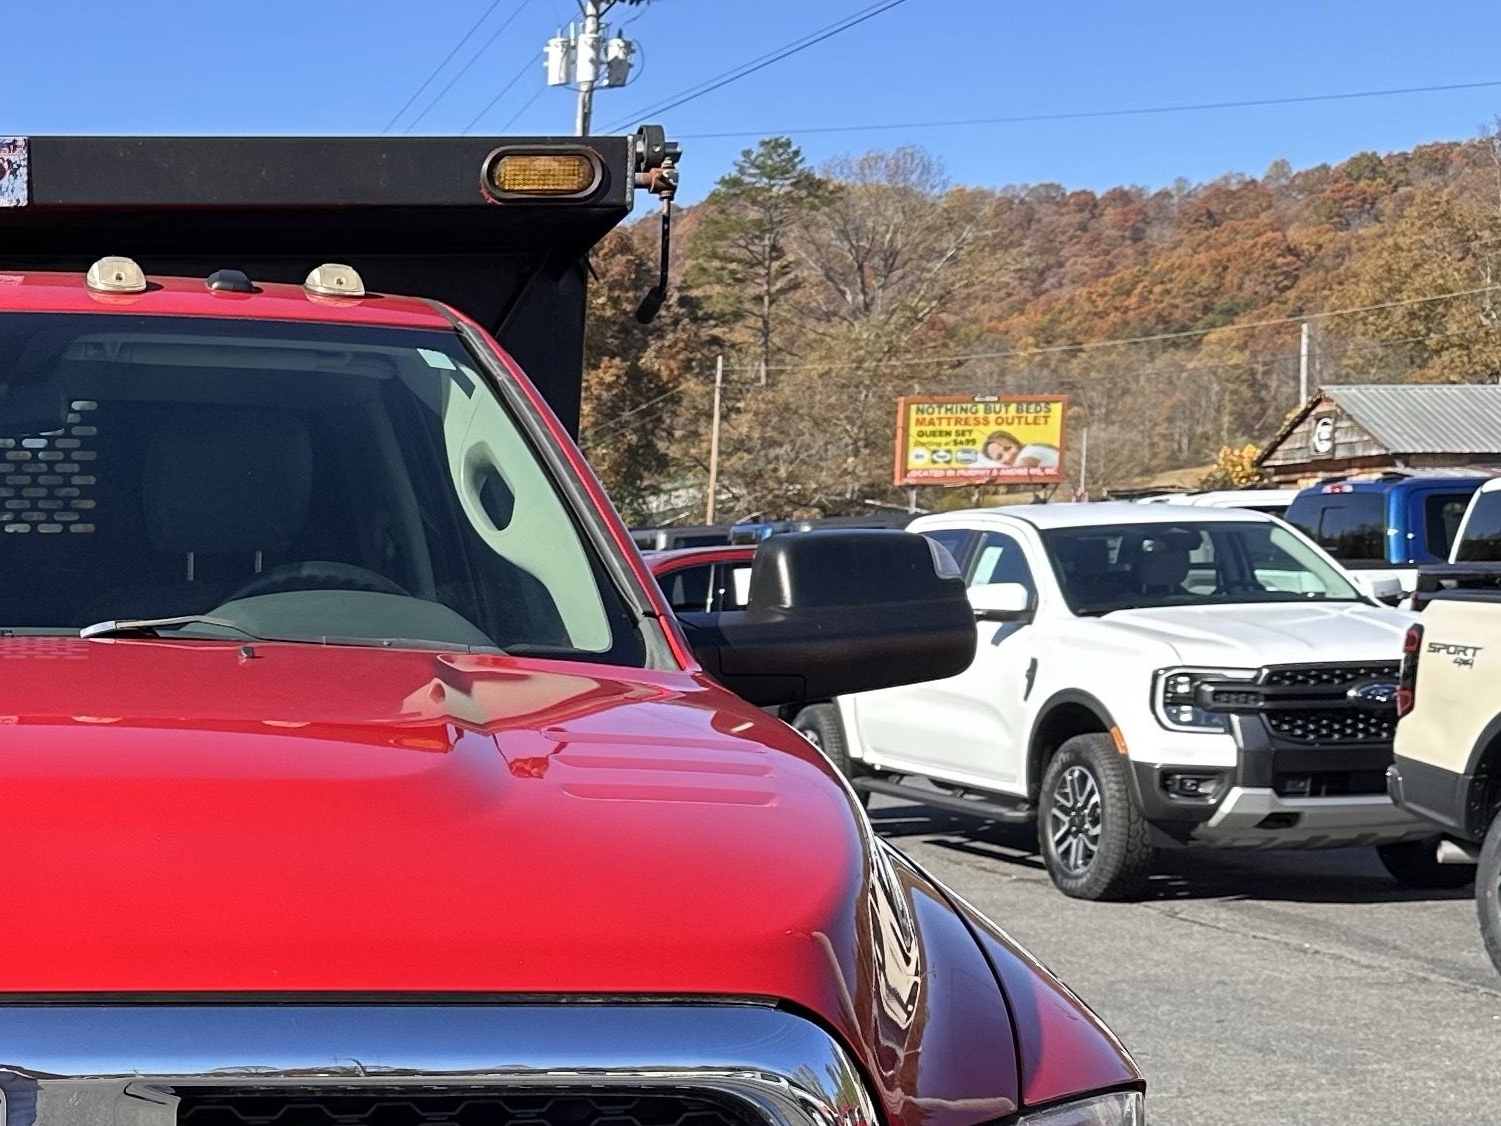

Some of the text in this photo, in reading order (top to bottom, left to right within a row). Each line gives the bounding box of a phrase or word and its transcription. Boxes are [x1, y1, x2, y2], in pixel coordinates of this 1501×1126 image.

[915, 403, 1052, 416] NOTHING BUT BEDS
[915, 415, 1051, 427] MATTRESS OUTLET
[917, 429, 974, 438] QUEEN SET
[953, 438, 977, 447] $499
[1427, 642, 1484, 657] SPORT
